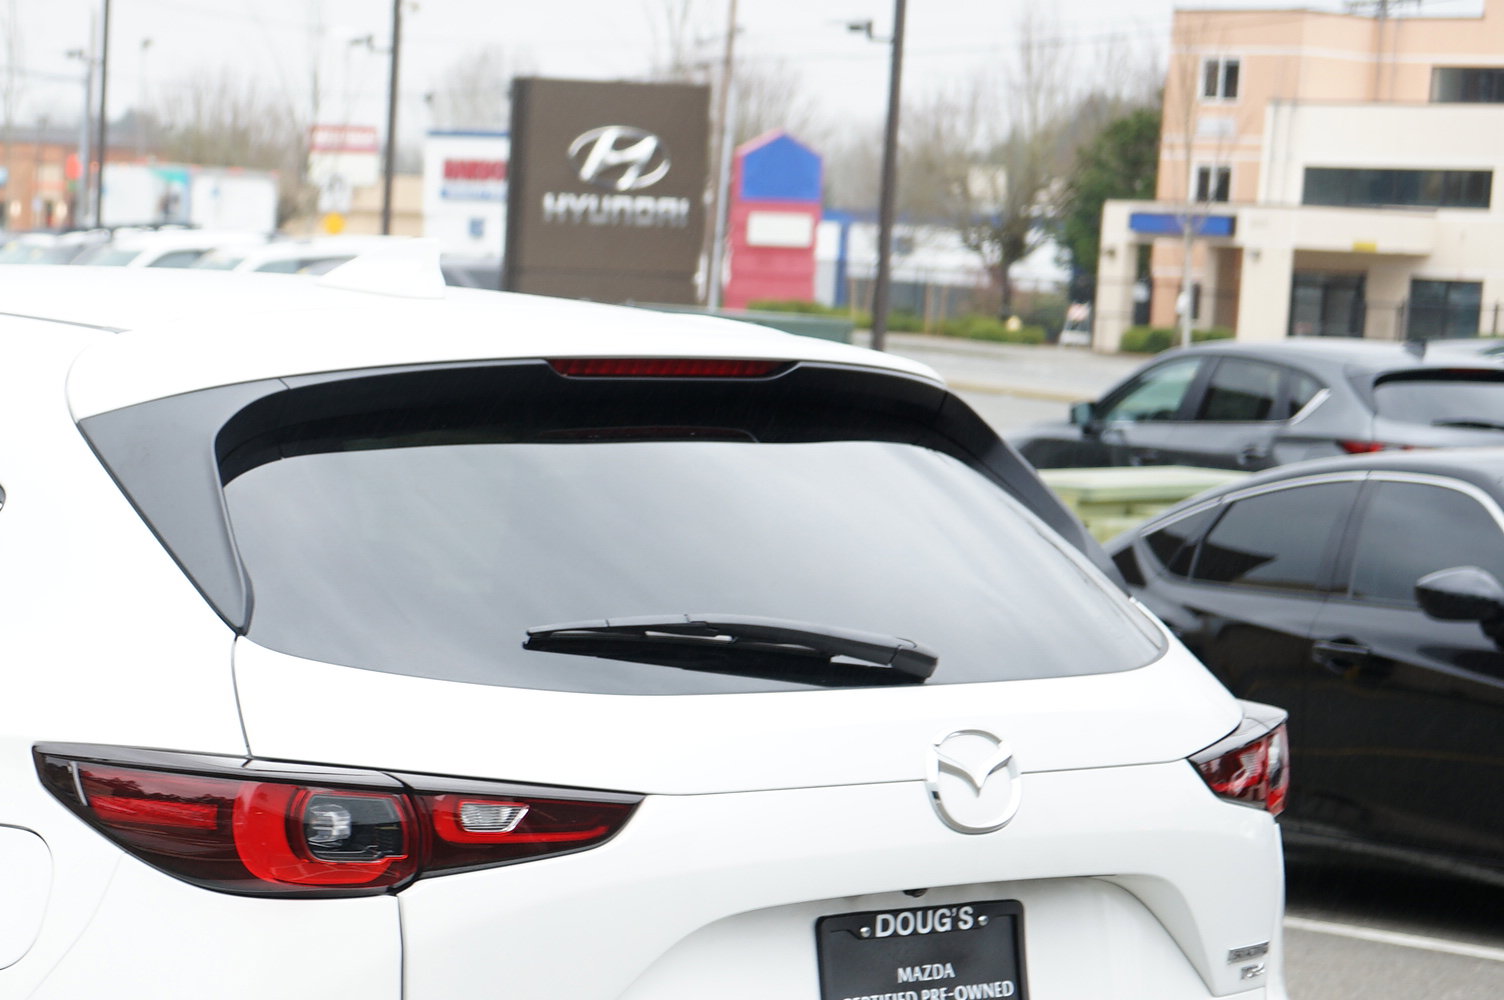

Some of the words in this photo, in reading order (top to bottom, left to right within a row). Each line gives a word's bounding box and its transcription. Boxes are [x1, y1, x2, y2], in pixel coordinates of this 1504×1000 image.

[543, 192, 690, 227] HYUNDAI
[875, 906, 974, 937] DOUG'S
[897, 963, 955, 983] MAZDA
